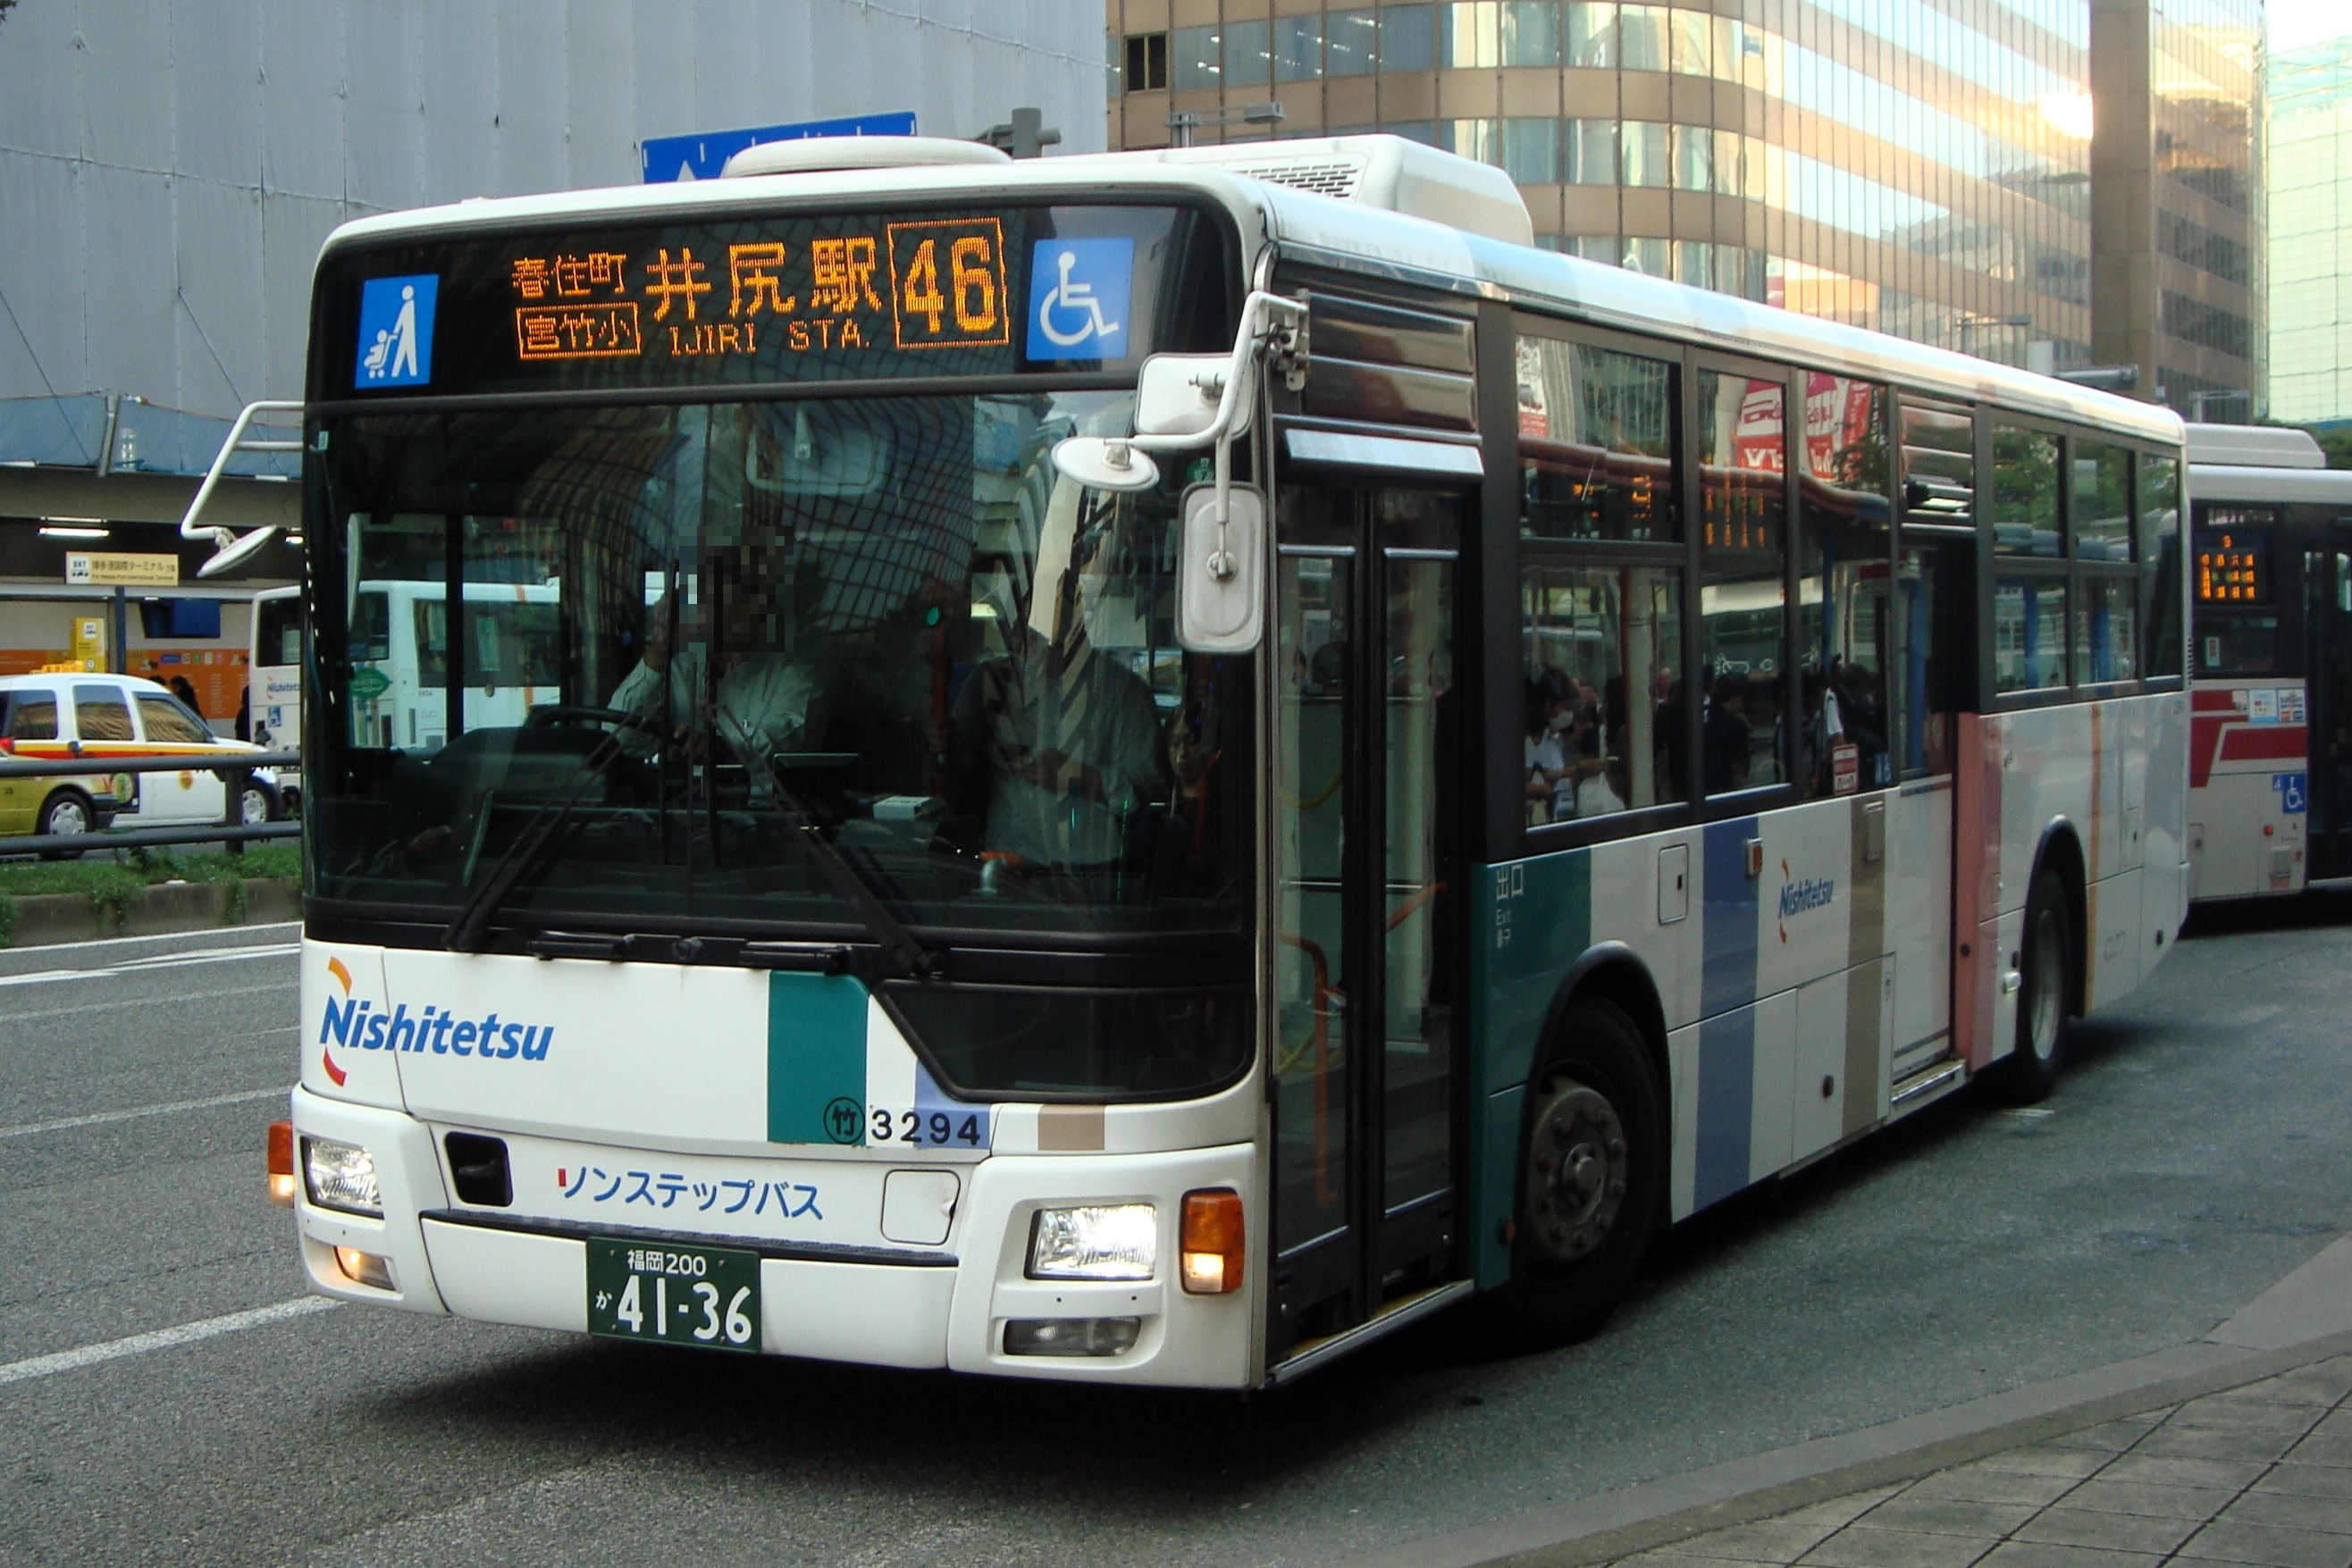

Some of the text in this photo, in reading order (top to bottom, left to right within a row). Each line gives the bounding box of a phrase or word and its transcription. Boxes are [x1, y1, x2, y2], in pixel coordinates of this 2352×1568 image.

[511, 251, 628, 298] 春住町
[646, 236, 883, 322] 井尻駅
[903, 236, 996, 334] 46
[669, 317, 871, 356] IJIRI STA.
[1778, 878, 1834, 919] Nishitetsu
[319, 994, 554, 1061] Nishitetsu
[871, 1109, 980, 1145] 3294
[564, 1166, 823, 1220] ノンステップバス
[595, 1274, 752, 1344] か 41-36
